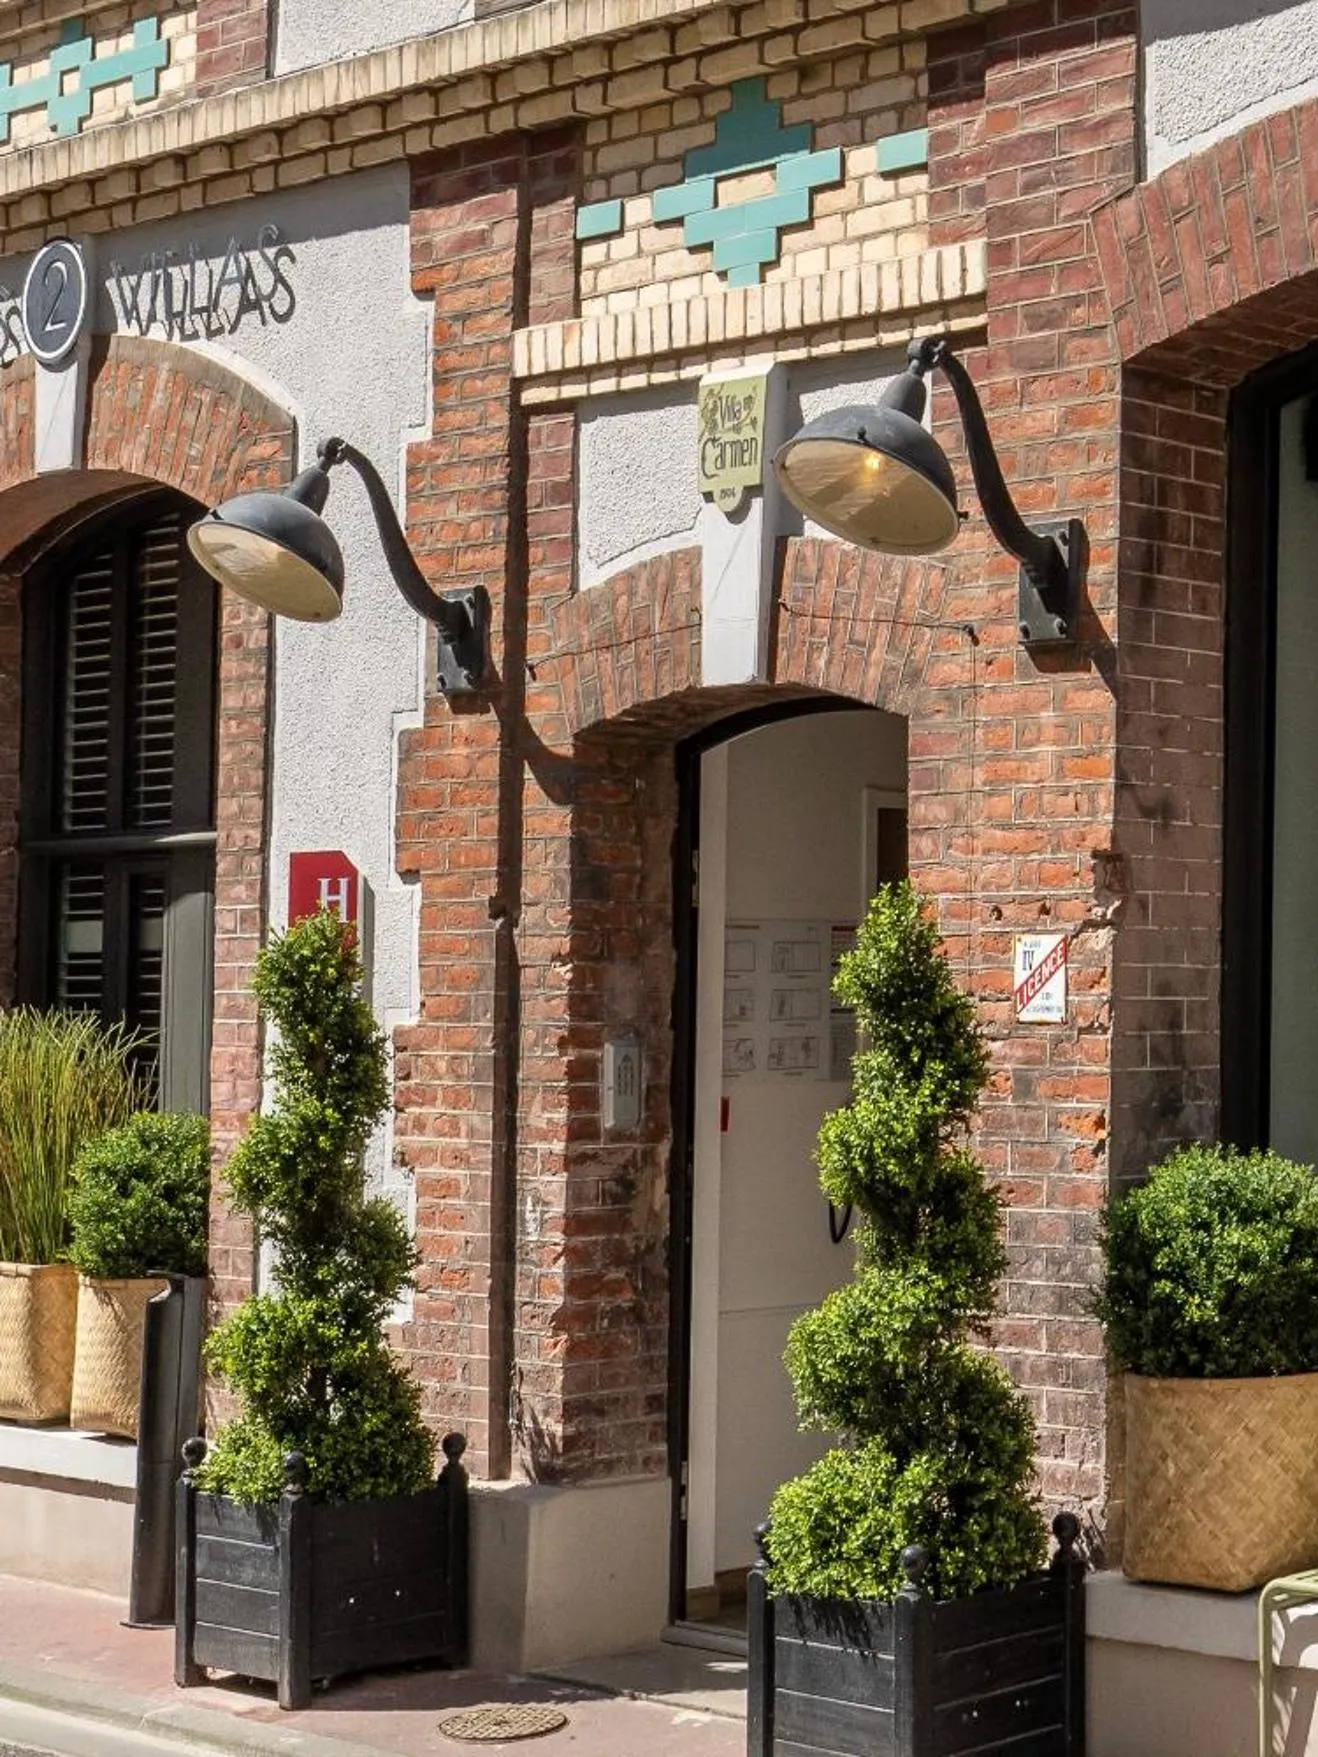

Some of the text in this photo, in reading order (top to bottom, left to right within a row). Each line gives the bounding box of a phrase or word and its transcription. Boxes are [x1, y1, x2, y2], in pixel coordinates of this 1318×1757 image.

[43, 258, 69, 332] 2
[701, 435, 758, 480] Carmen
[317, 877, 350, 924] H
[1015, 940, 1066, 1014] LICENCE
